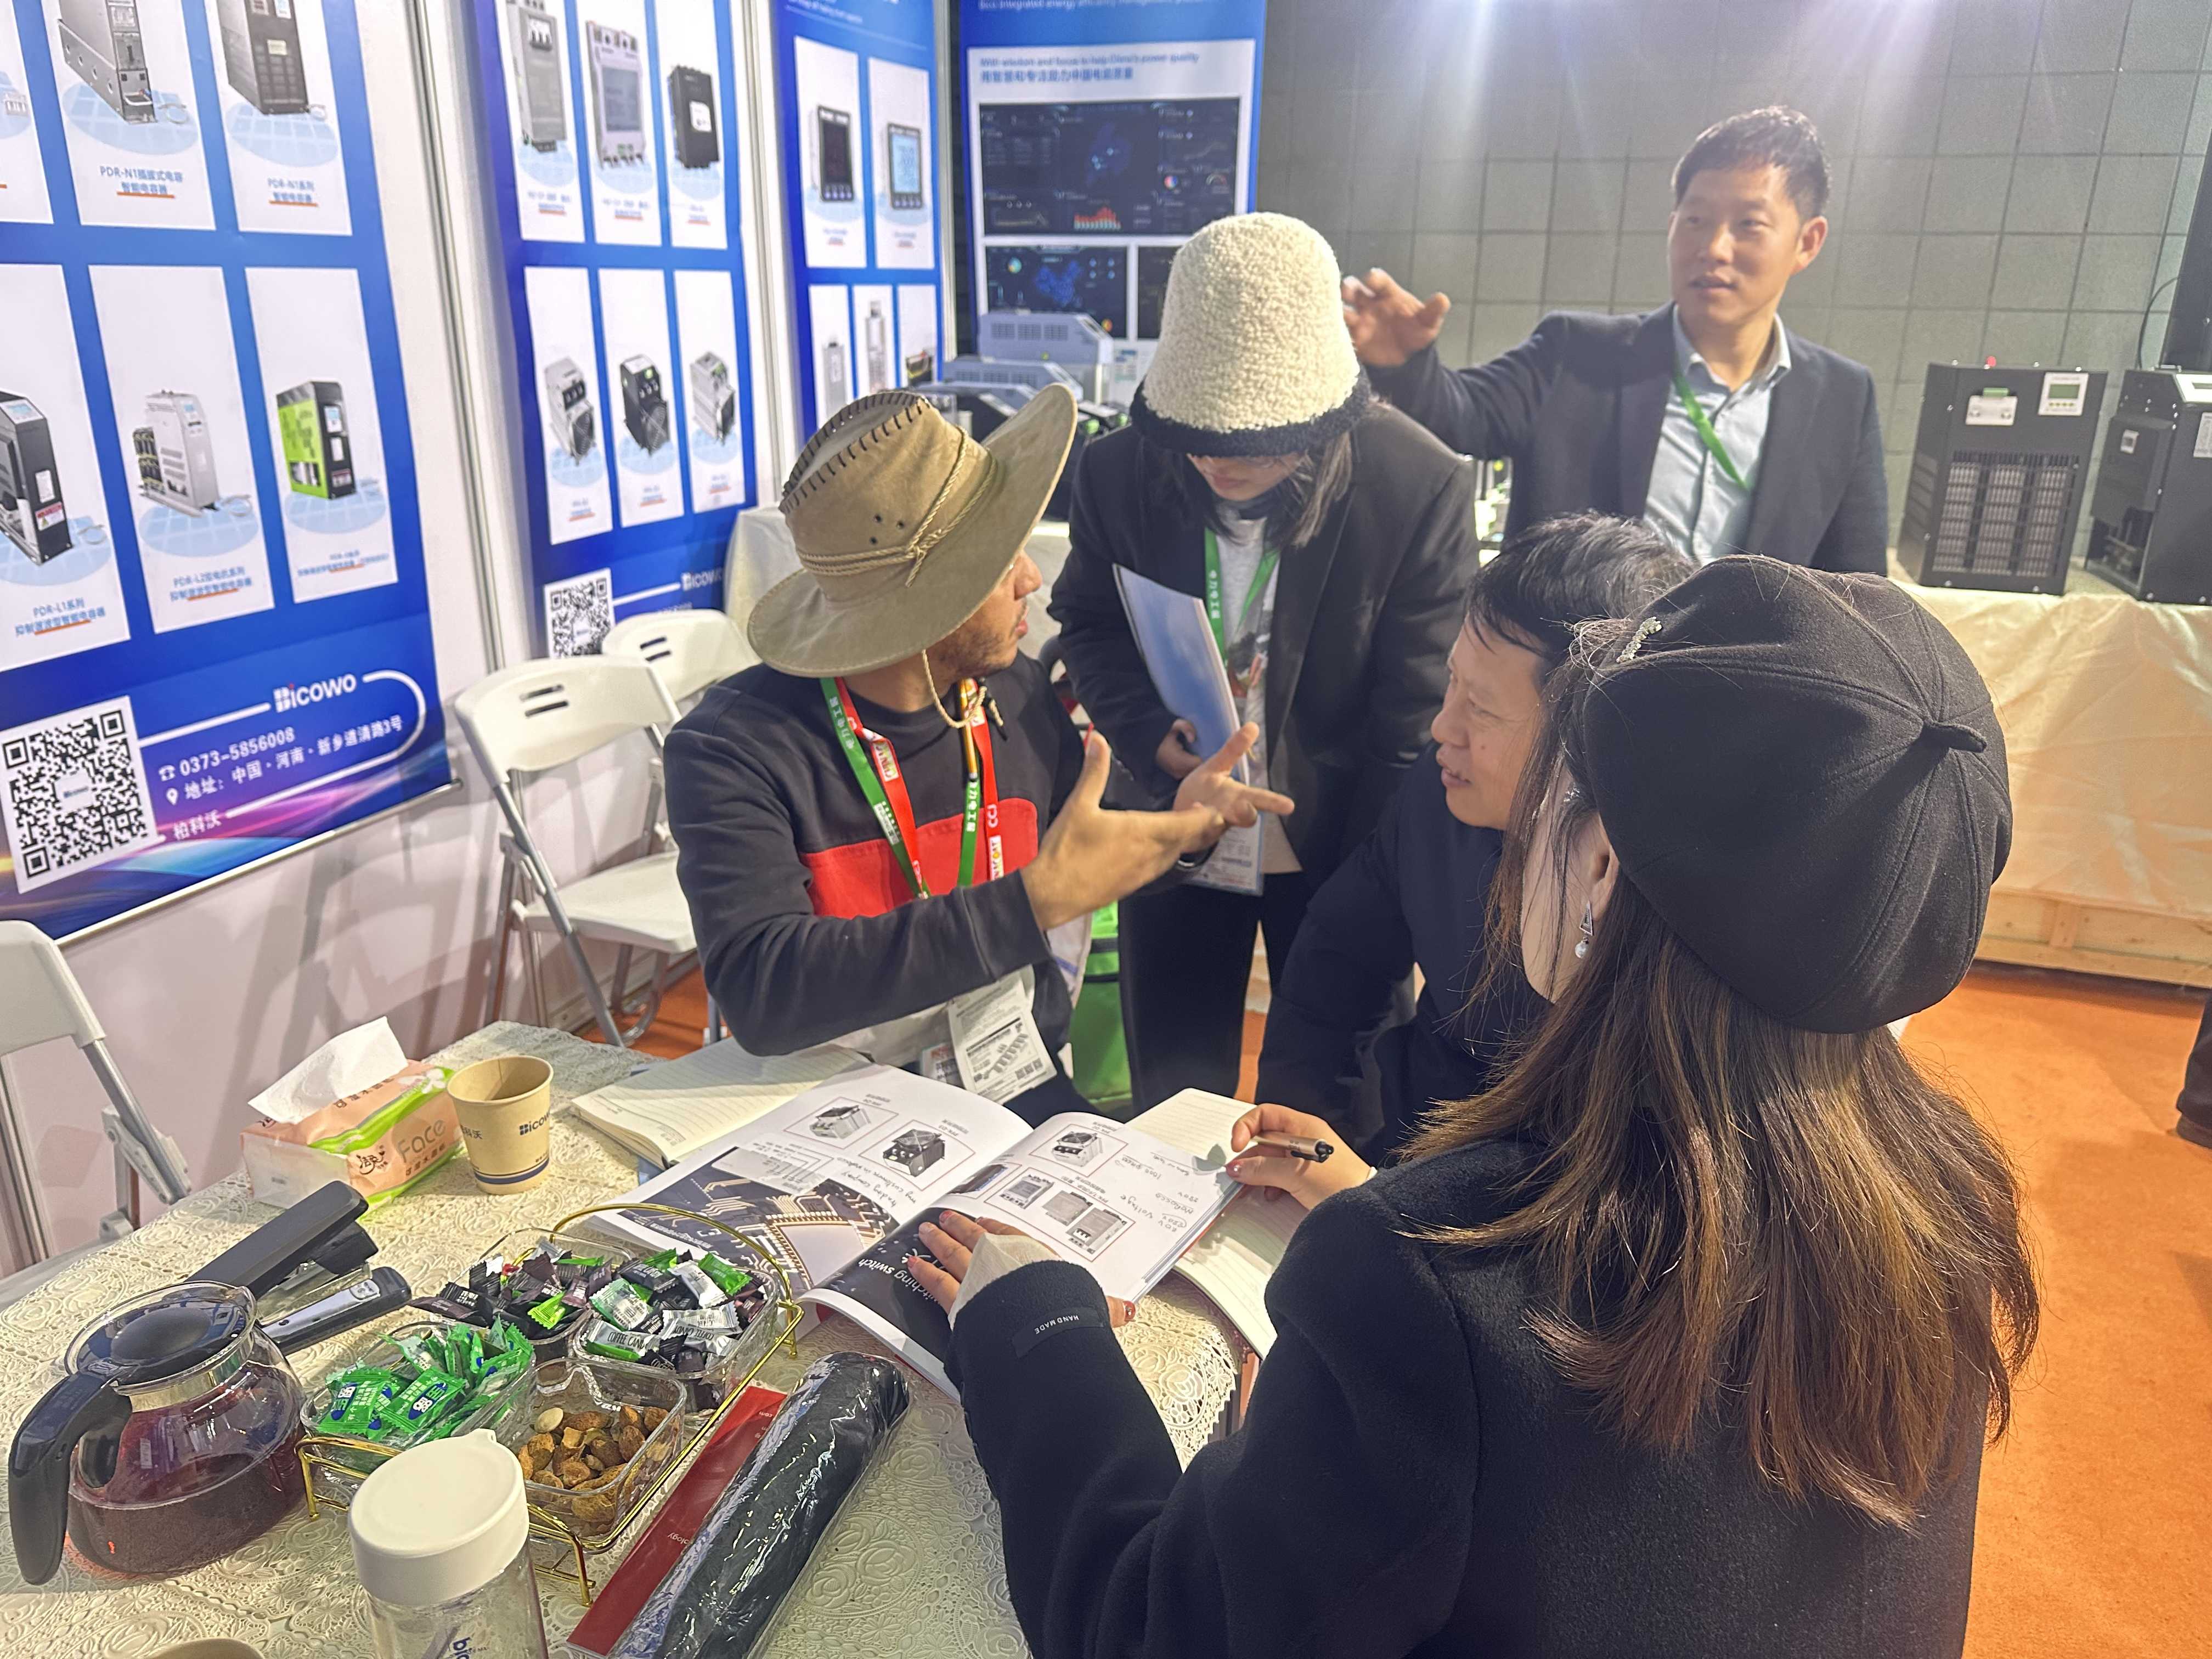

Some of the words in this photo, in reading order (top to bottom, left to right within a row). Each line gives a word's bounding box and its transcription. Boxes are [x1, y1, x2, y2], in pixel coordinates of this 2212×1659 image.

[178, 726, 296, 777] 0373-5856008
[173, 809, 222, 841] 柏科沃
[460, 1125, 483, 1140] 科沃
[857, 1258, 895, 1274] switch
[894, 1269, 939, 1305] witching
[1034, 1319, 1056, 1334] MADE
[1057, 1314, 1079, 1323] HAND
[607, 1331, 628, 1342] COFFEE
[627, 1335, 646, 1350] CAND
